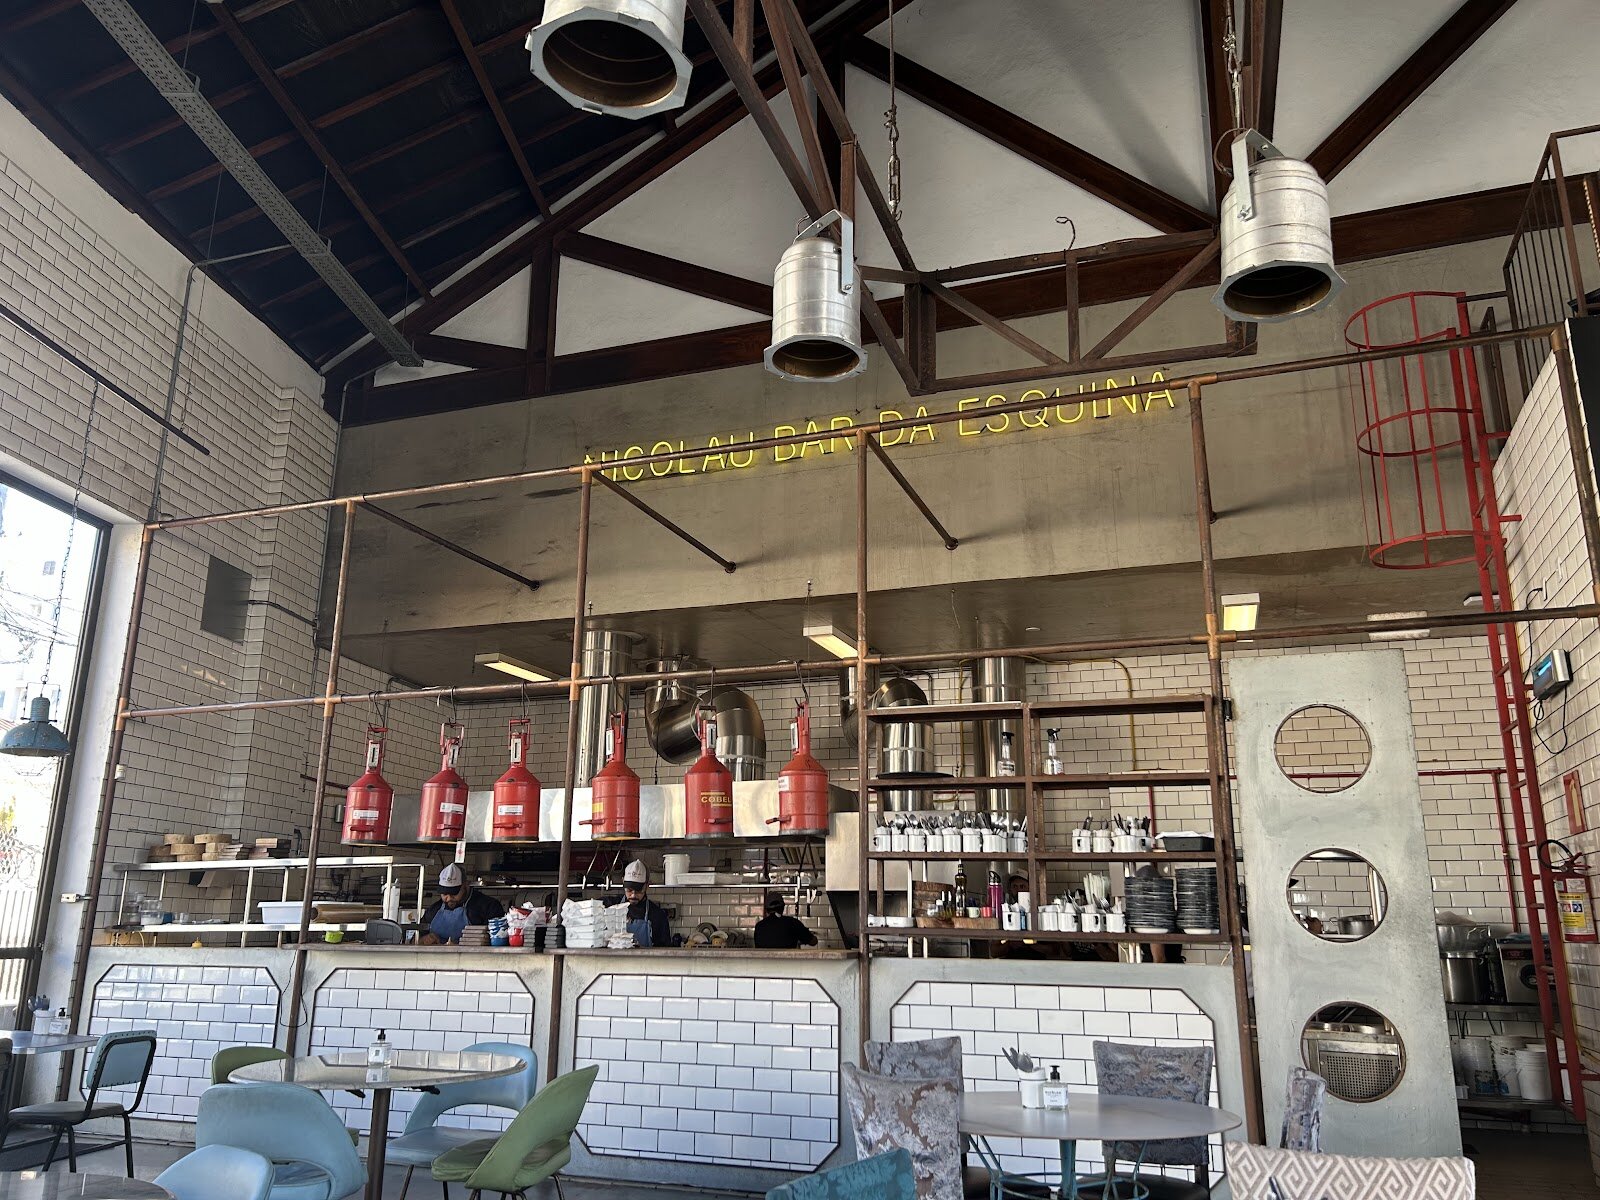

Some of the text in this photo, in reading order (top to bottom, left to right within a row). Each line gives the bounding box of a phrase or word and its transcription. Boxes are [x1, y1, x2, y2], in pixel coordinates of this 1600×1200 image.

[773, 415, 855, 462] BAR
[878, 405, 936, 448] DA
[957, 370, 1176, 436] ESQUINA
